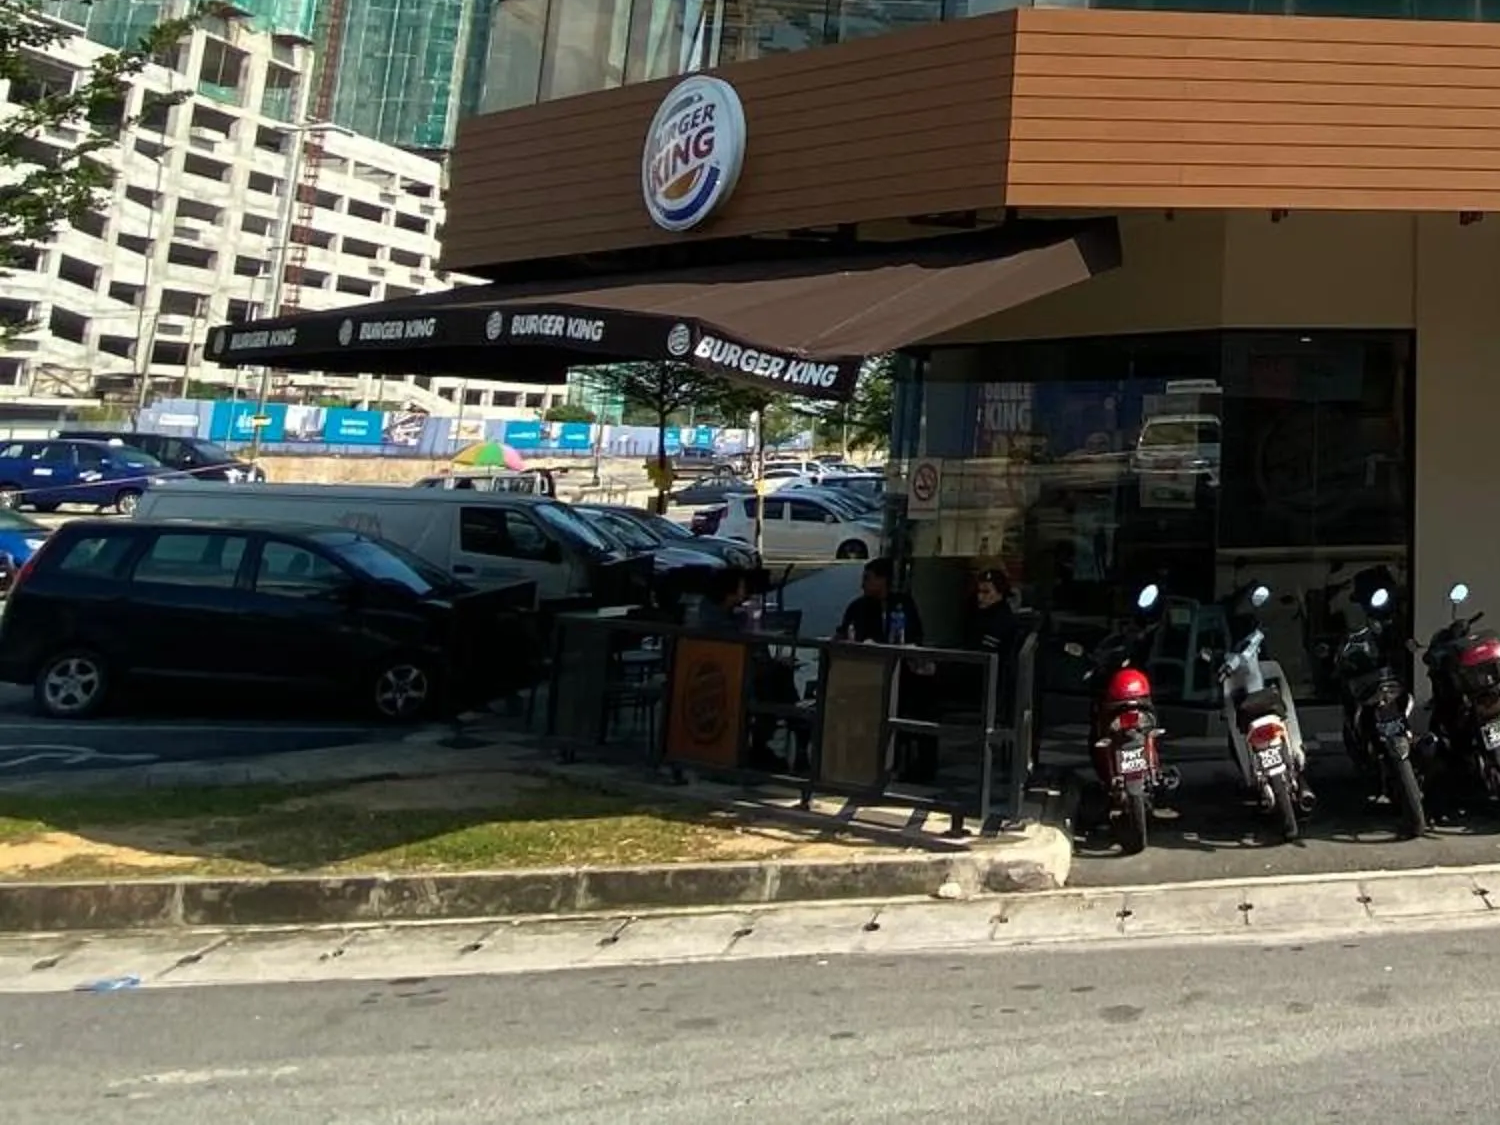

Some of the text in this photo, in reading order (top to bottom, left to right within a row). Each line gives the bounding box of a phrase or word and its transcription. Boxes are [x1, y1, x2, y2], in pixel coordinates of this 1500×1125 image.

[651, 125, 715, 198] KING
[358, 321, 402, 341] BURGER
[403, 318, 437, 339] KING
[510, 314, 565, 337] BURGER
[566, 318, 604, 342] KING
[693, 335, 787, 378] BURGER
[783, 361, 840, 388] KING
